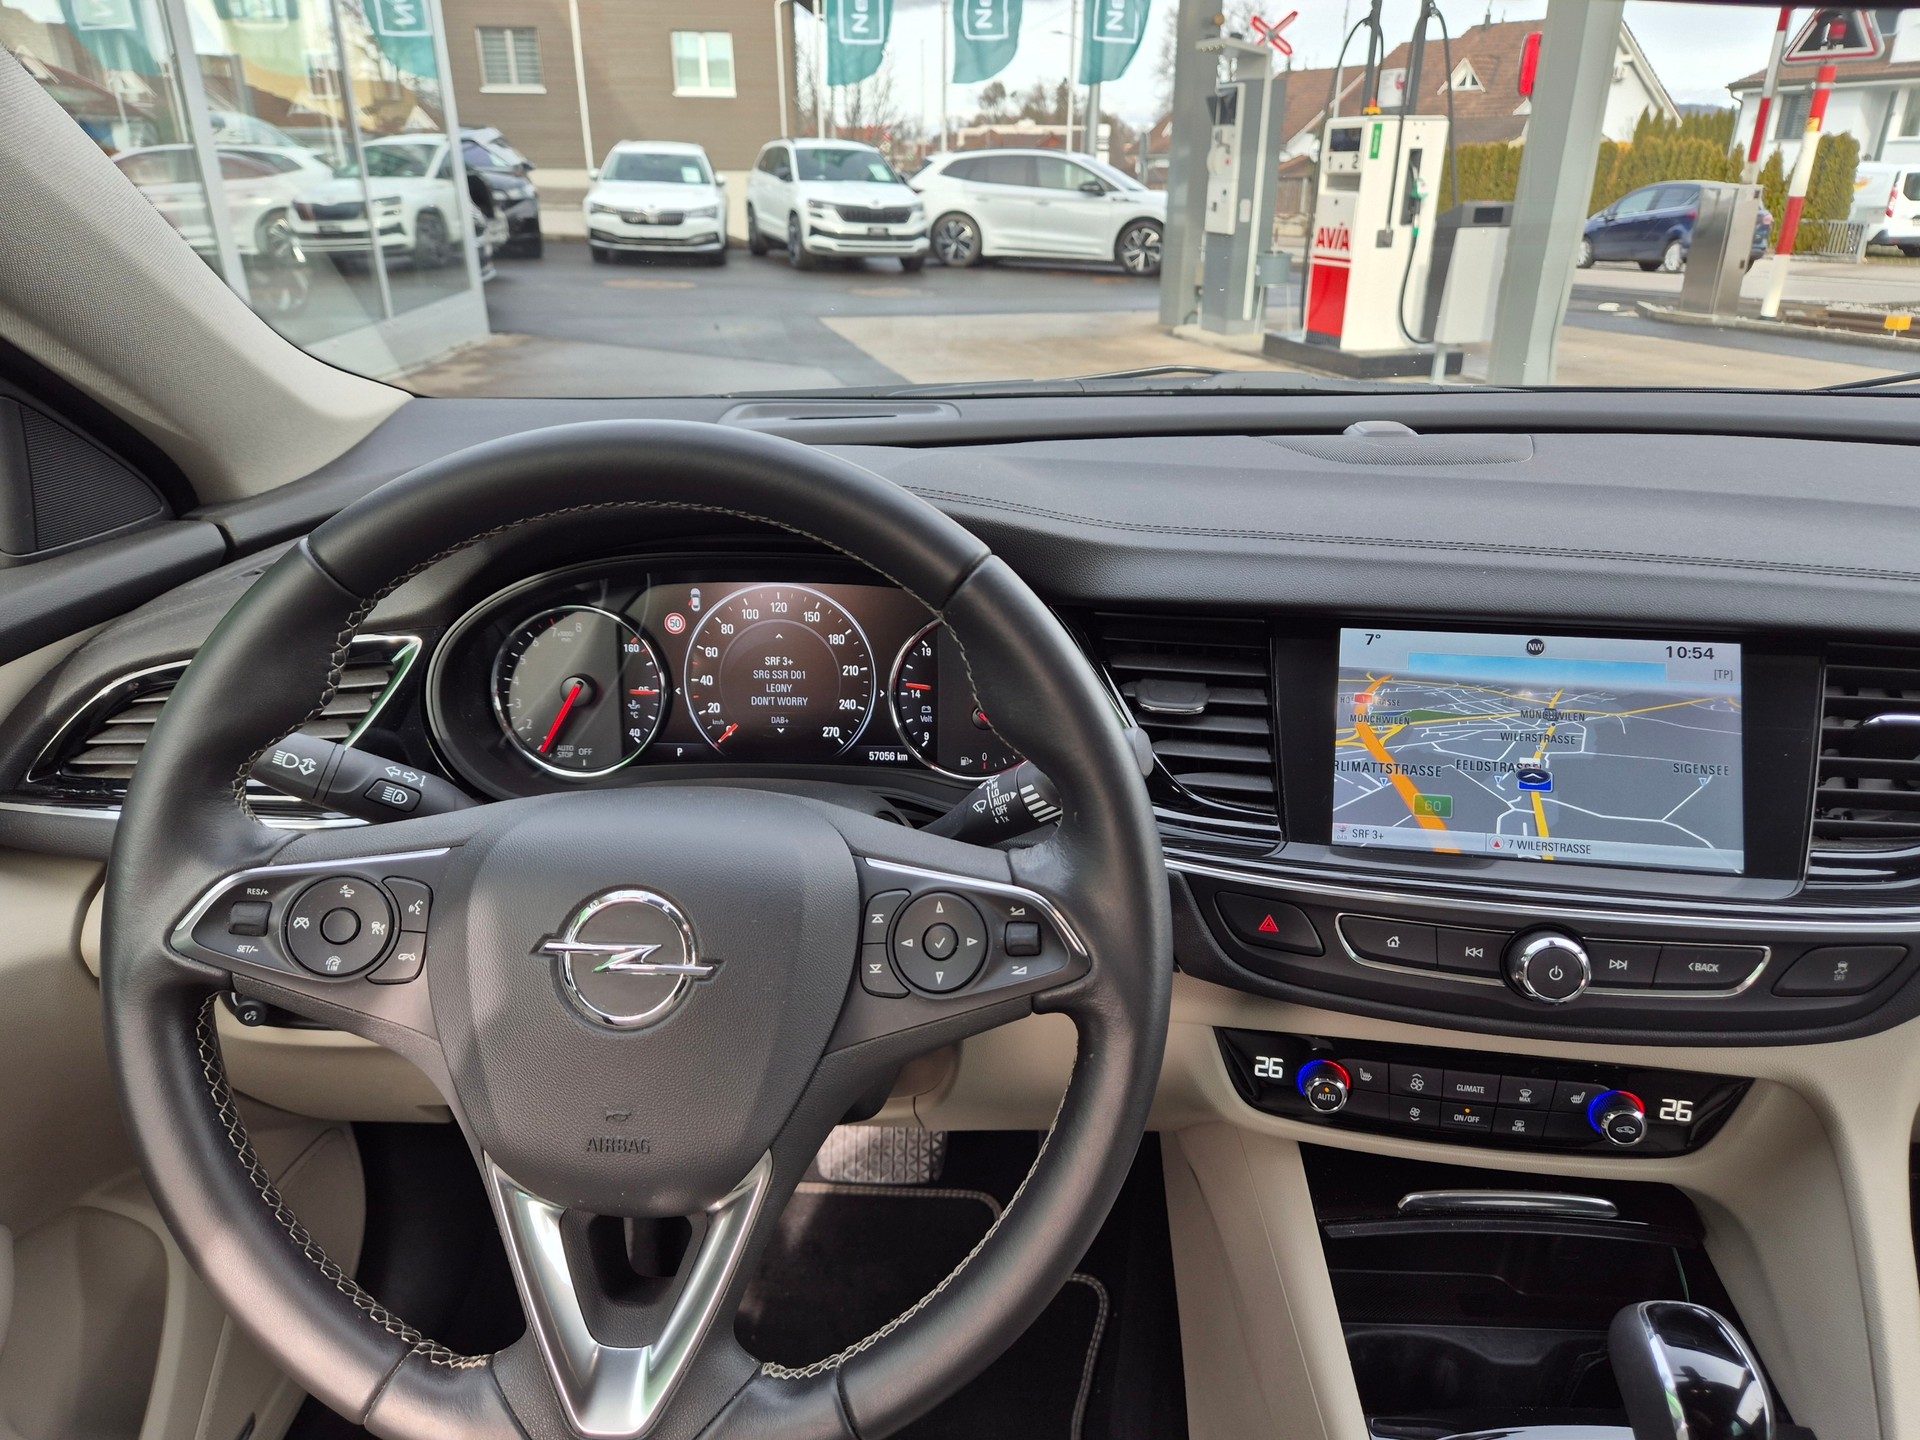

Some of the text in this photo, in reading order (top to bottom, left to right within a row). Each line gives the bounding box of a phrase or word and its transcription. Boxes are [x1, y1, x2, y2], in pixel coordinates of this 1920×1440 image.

[1315, 223, 1351, 251] AVIA
[770, 602, 788, 613] 120
[741, 609, 759, 620] 100
[803, 611, 821, 623] 150
[669, 617, 681, 629] 50
[720, 624, 734, 635] 80
[828, 634, 845, 645] 180
[623, 643, 640, 653] 160
[921, 647, 932, 656] 19
[1528, 642, 1544, 651] NW
[705, 647, 718, 658] 60
[1665, 645, 1715, 660] 10:54
[520, 654, 526, 665] 5
[764, 656, 794, 666] SRF 3+
[752, 670, 770, 679] SRG
[772, 670, 788, 679] SSR
[842, 665, 859, 676] 210
[513, 676, 519, 686] 4
[700, 675, 713, 686] 40
[766, 684, 793, 693] LEONY
[910, 690, 921, 699] 14
[515, 698, 521, 708] 3
[751, 696, 808, 706] DON'T WORRY
[838, 699, 856, 710] 240
[707, 703, 721, 714] 20
[526, 719, 533, 729] 2
[770, 716, 789, 724] DAB+
[920, 715, 933, 723] Volt
[629, 728, 641, 737] 40
[822, 727, 840, 738] 270
[923, 732, 930, 740] 9
[1500, 732, 1576, 745] WILERSTRASSE
[578, 747, 593, 756] OFF
[676, 747, 683, 757] P
[868, 751, 908, 761] 57056 km
[981, 752, 988, 761] 0
[1673, 762, 1729, 776] SIGENSEE
[991, 788, 1000, 798] LO
[993, 793, 1010, 807] AUTO
[1424, 800, 1442, 812] 60
[1352, 828, 1384, 840] SRF 3+
[1508, 839, 1592, 854] 7 WILERSTRASSE
[1254, 1055, 1284, 1079] 26
[1456, 1083, 1485, 1094] CLIMATE
[1317, 1092, 1336, 1102] AUTO
[1659, 1098, 1694, 1122] 26
[1453, 1114, 1480, 1123] ON/OFF
[586, 1136, 651, 1154] AIRBAG
